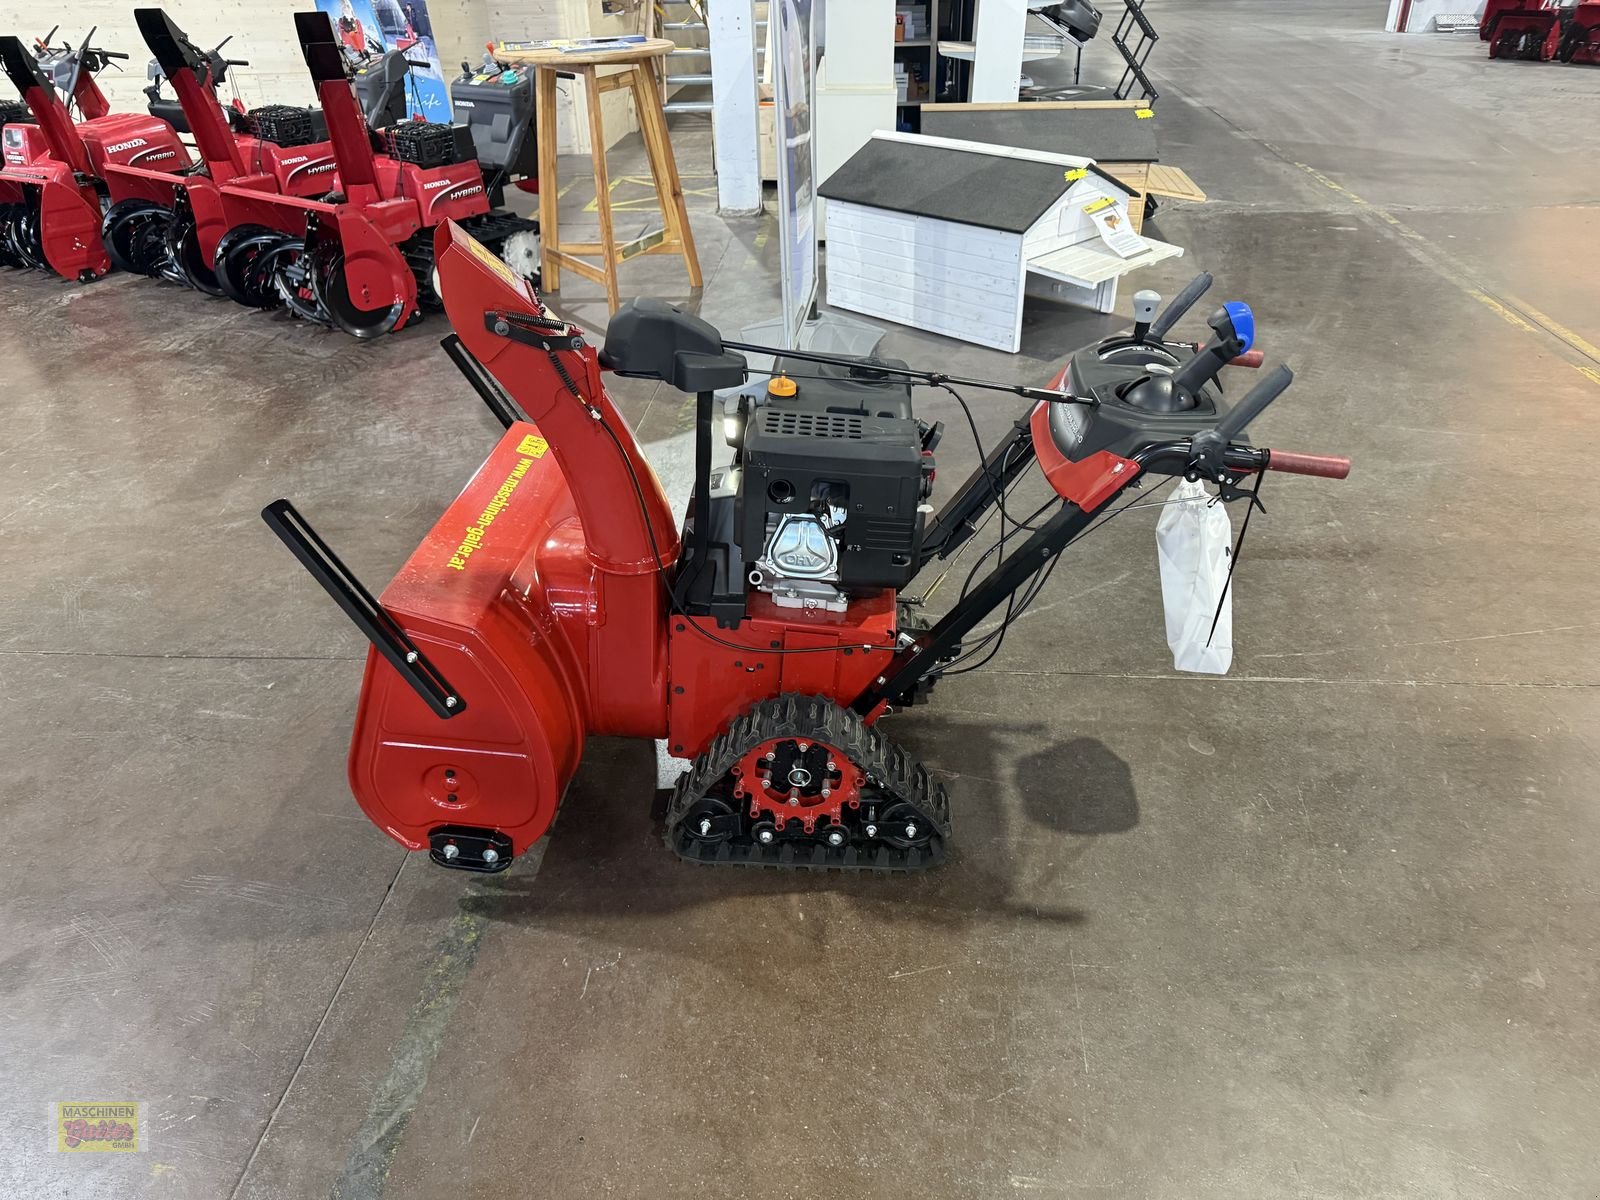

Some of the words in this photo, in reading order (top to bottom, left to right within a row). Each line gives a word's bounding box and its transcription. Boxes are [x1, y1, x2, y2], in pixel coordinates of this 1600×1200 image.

[454, 100, 475, 108] HONDA
[107, 138, 147, 154] HONDA
[146, 151, 175, 162] HYBRID
[281, 155, 308, 165] HONDA
[423, 178, 451, 190] HONDA
[450, 185, 482, 201] HYBRID
[447, 458, 533, 570] www.maschinen-gailer.at
[785, 554, 817, 566] OHV
